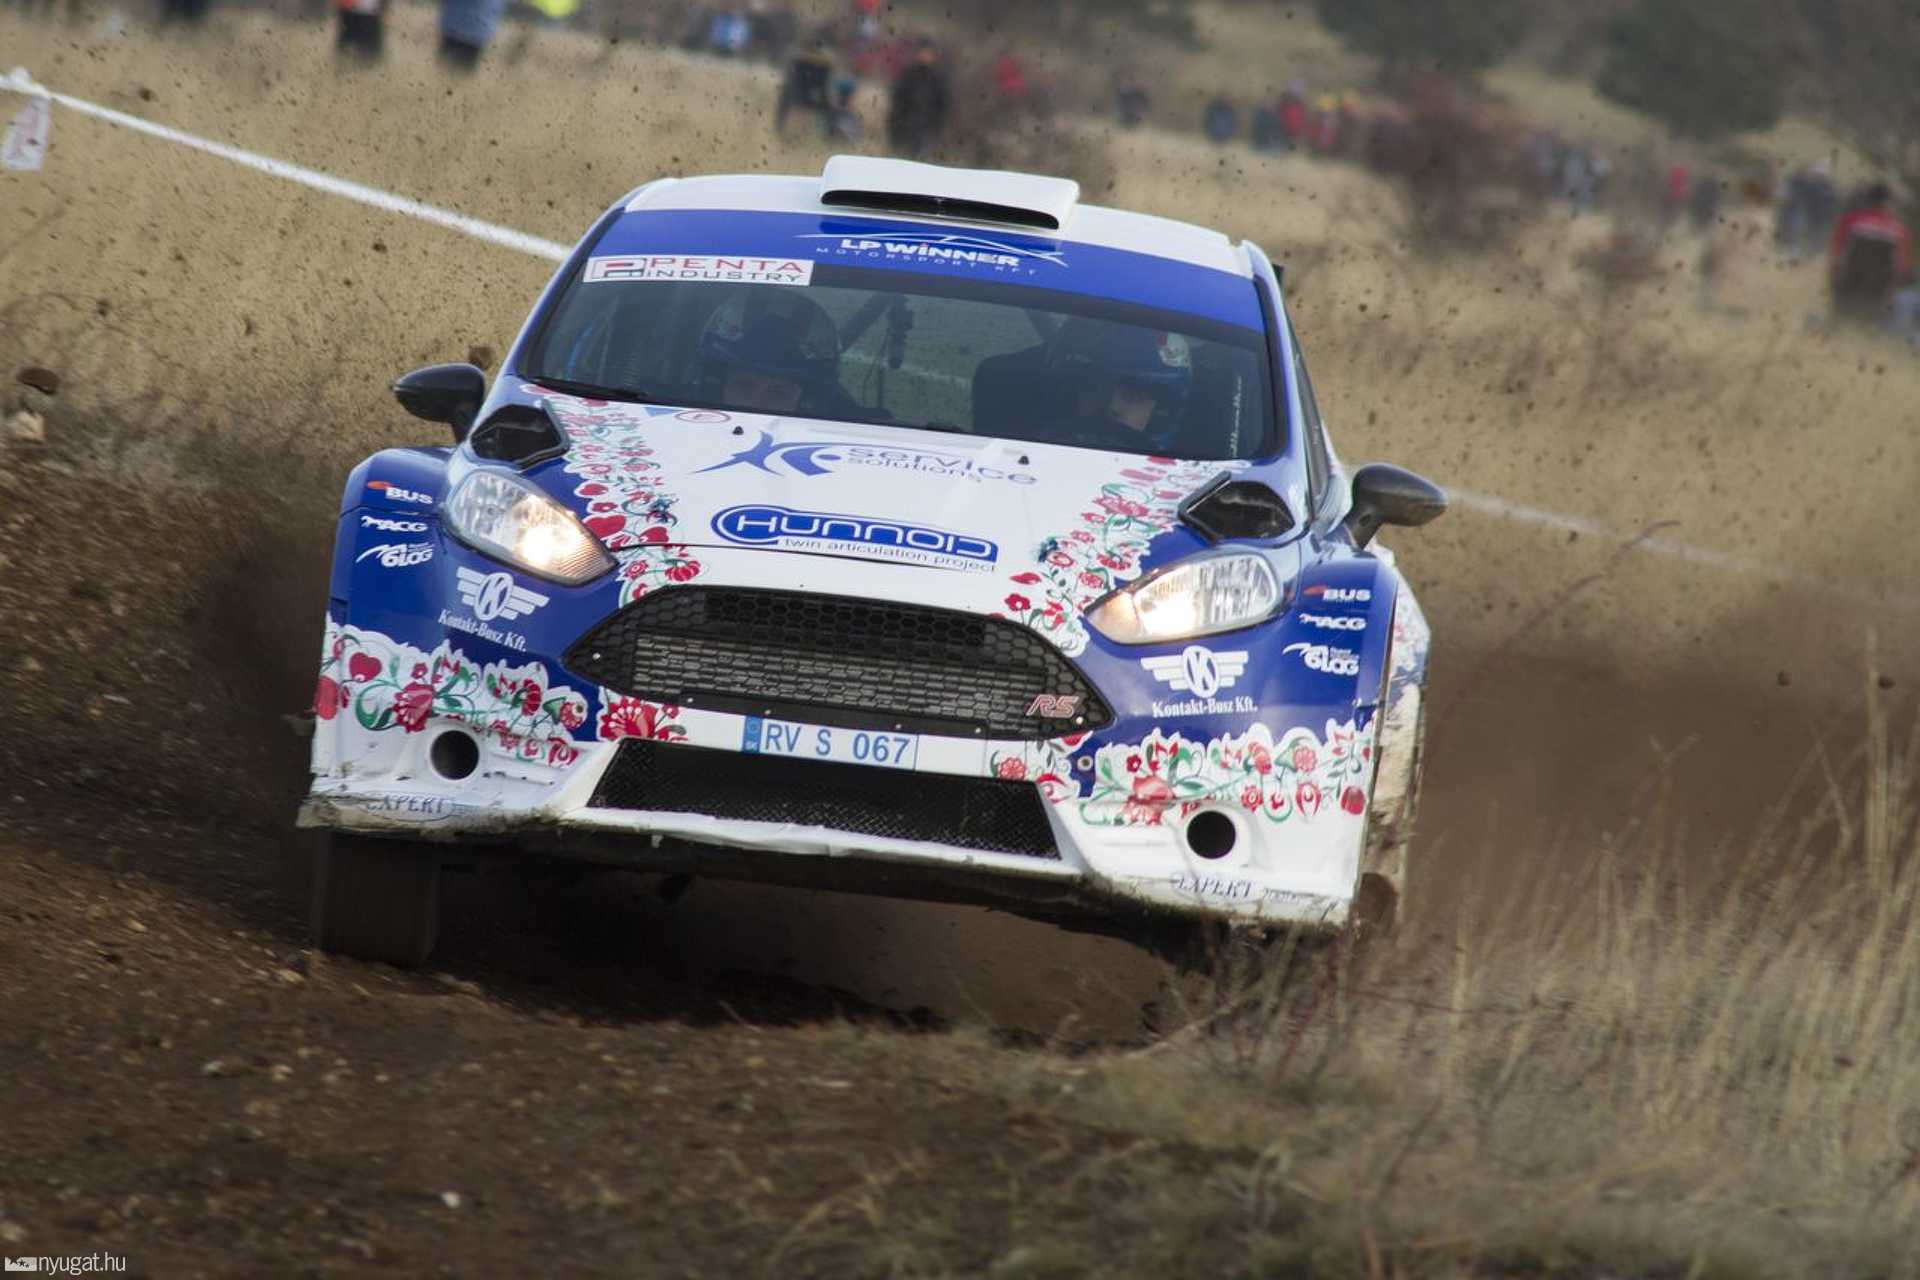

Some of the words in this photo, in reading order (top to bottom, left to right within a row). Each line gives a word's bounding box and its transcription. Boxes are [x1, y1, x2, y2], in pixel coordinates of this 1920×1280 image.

[841, 239, 882, 250] LP
[650, 257, 804, 273] PENTA
[849, 447, 1037, 485] service
[386, 487, 433, 504] BUS
[784, 537, 822, 549] twin
[827, 540, 927, 562] articulation
[934, 555, 996, 573] project
[1323, 589, 1371, 602] BUS
[504, 631, 527, 653] Kft.
[1026, 694, 1079, 718] RS
[1152, 698, 1234, 718] Kontakt-Busz
[1235, 696, 1258, 713] Kft.
[765, 723, 801, 751] RV
[815, 729, 832, 756] S
[853, 733, 911, 765] 067
